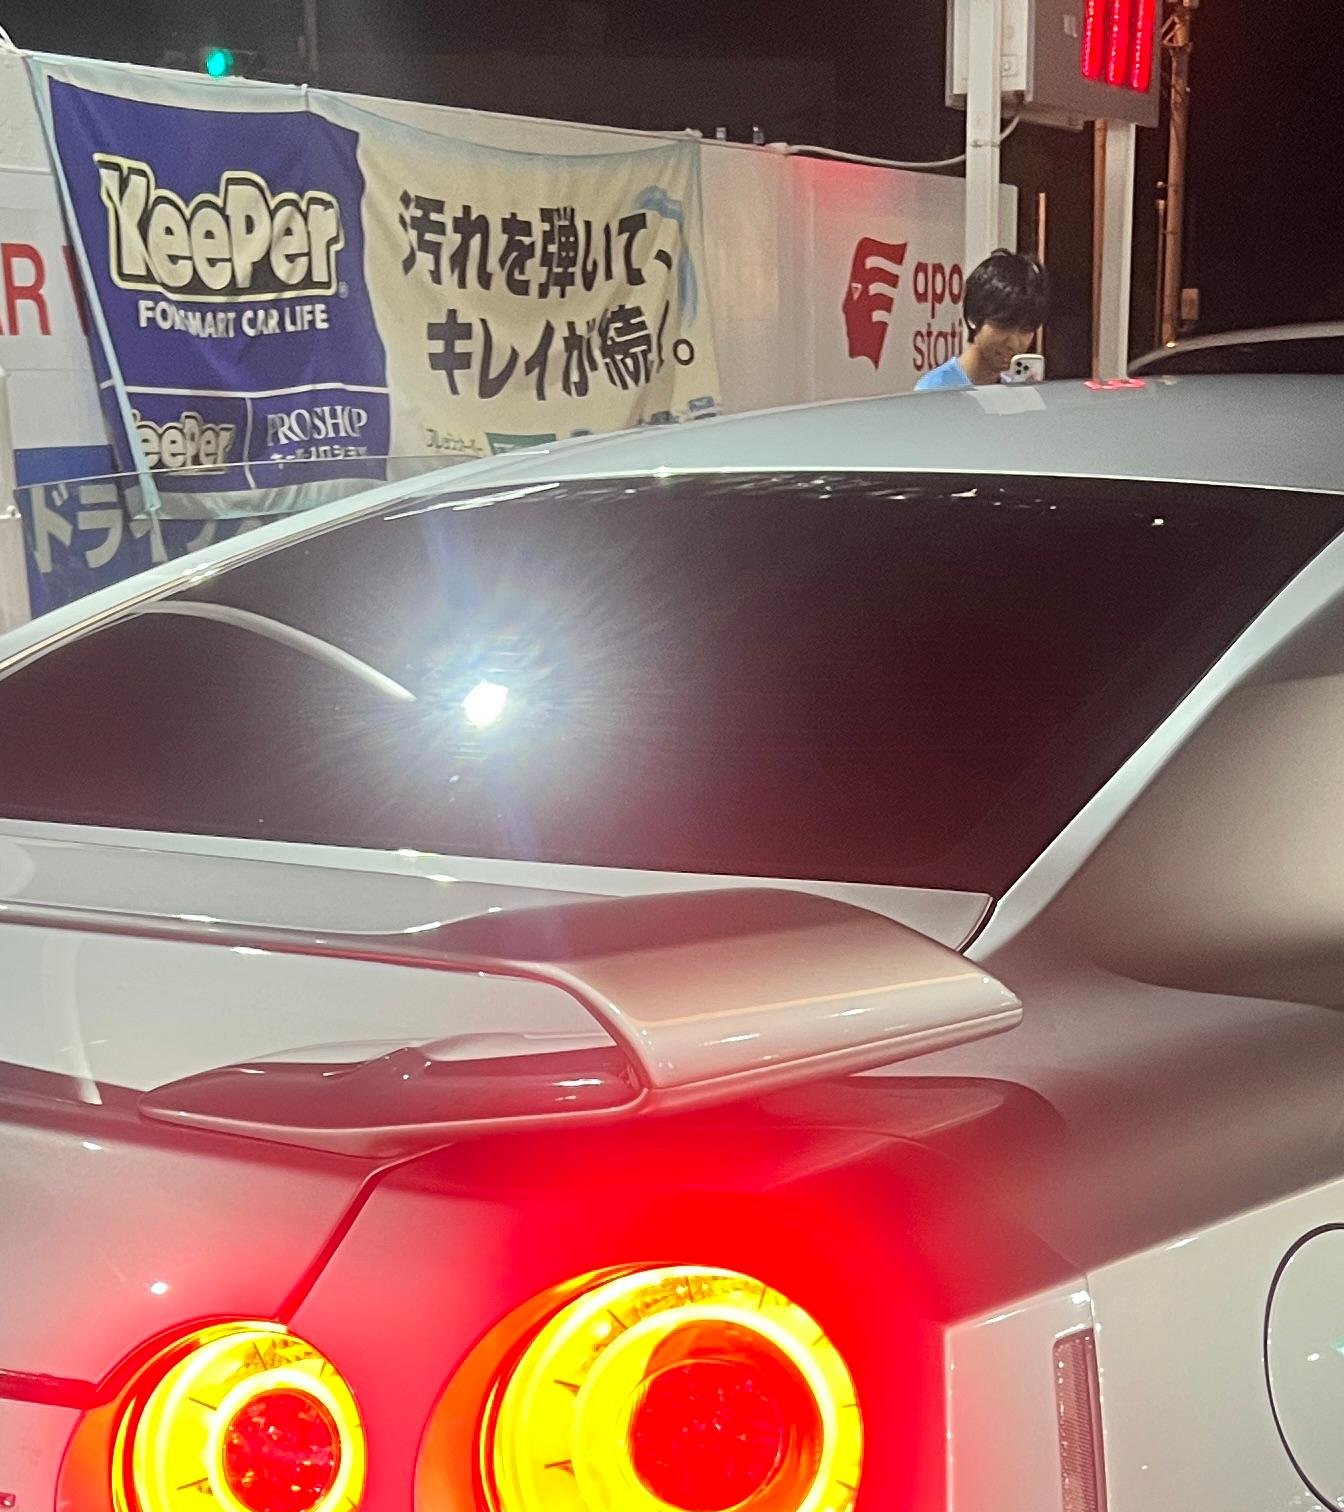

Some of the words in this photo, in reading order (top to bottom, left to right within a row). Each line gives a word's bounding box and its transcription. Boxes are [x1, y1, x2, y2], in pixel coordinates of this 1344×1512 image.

[93, 154, 344, 300] KeePer
[399, 190, 672, 299] 汚れを弾いて、
[241, 309, 280, 337] CAR
[284, 303, 330, 333] LIFE
[913, 262, 964, 319] apo
[132, 411, 235, 475] eePer
